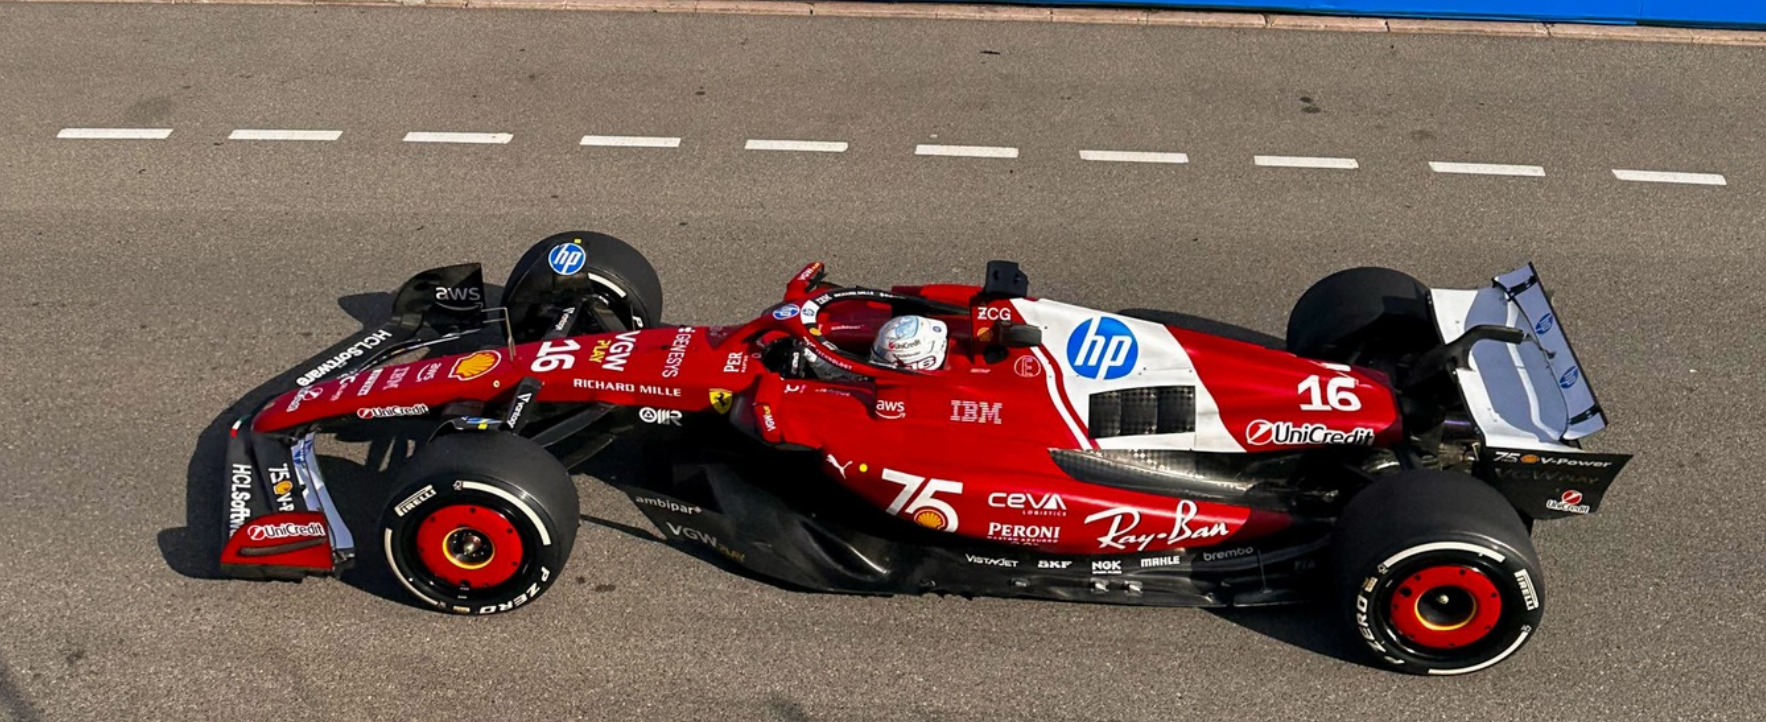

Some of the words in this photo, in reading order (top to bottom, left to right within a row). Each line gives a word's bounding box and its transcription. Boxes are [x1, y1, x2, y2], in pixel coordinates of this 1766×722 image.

[553, 243, 584, 275] hp
[435, 287, 481, 301] aws
[296, 330, 393, 387] HCLSoftware
[530, 339, 581, 373] 16
[589, 340, 612, 363] PLAY
[602, 330, 641, 371] VGW
[662, 333, 691, 379] GENESYS
[1073, 317, 1133, 380] hp
[573, 377, 635, 393] RICHARD
[639, 383, 682, 398] MILLE
[1297, 374, 1363, 412] 16
[875, 400, 906, 412] aws
[950, 399, 1003, 424] IBM
[1274, 421, 1376, 446] UniCredit
[1493, 451, 1522, 463] 75
[1540, 457, 1613, 468] V-Power
[881, 467, 964, 533] 75
[264, 522, 326, 538] UniCredit
[666, 521, 718, 548] VGW
[987, 521, 1061, 539] PERONI
[1084, 499, 1230, 552] Ray-Ban
[1091, 560, 1122, 570] NGK
[1140, 555, 1181, 568] MAHLE
[1203, 546, 1254, 561] brembo
[479, 582, 541, 614] ZERO
[1513, 568, 1540, 611] PIRELLI
